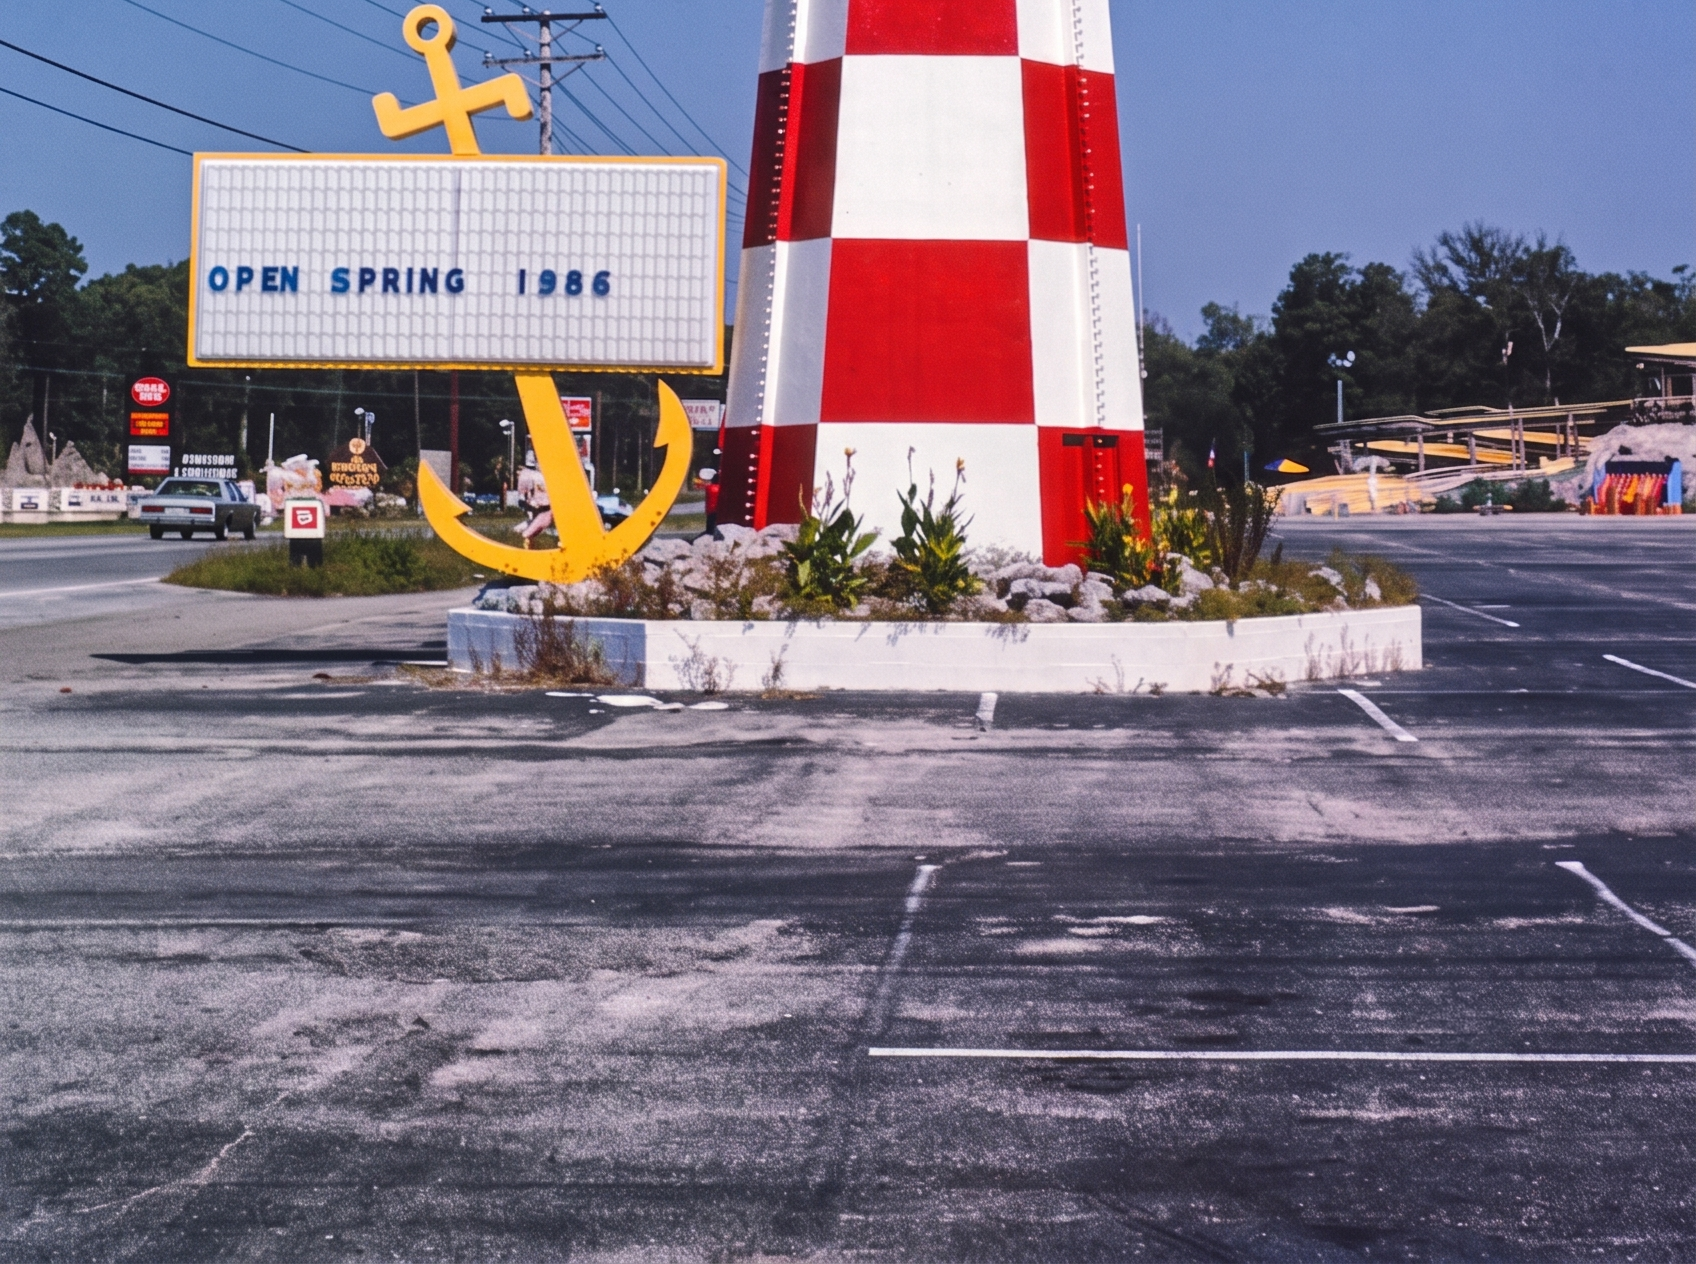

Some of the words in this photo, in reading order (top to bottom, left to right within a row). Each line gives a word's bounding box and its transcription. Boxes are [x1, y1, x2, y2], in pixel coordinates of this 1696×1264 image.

[208, 265, 299, 294] OPEN
[330, 267, 465, 295] SPRING
[518, 268, 611, 297] 1986
